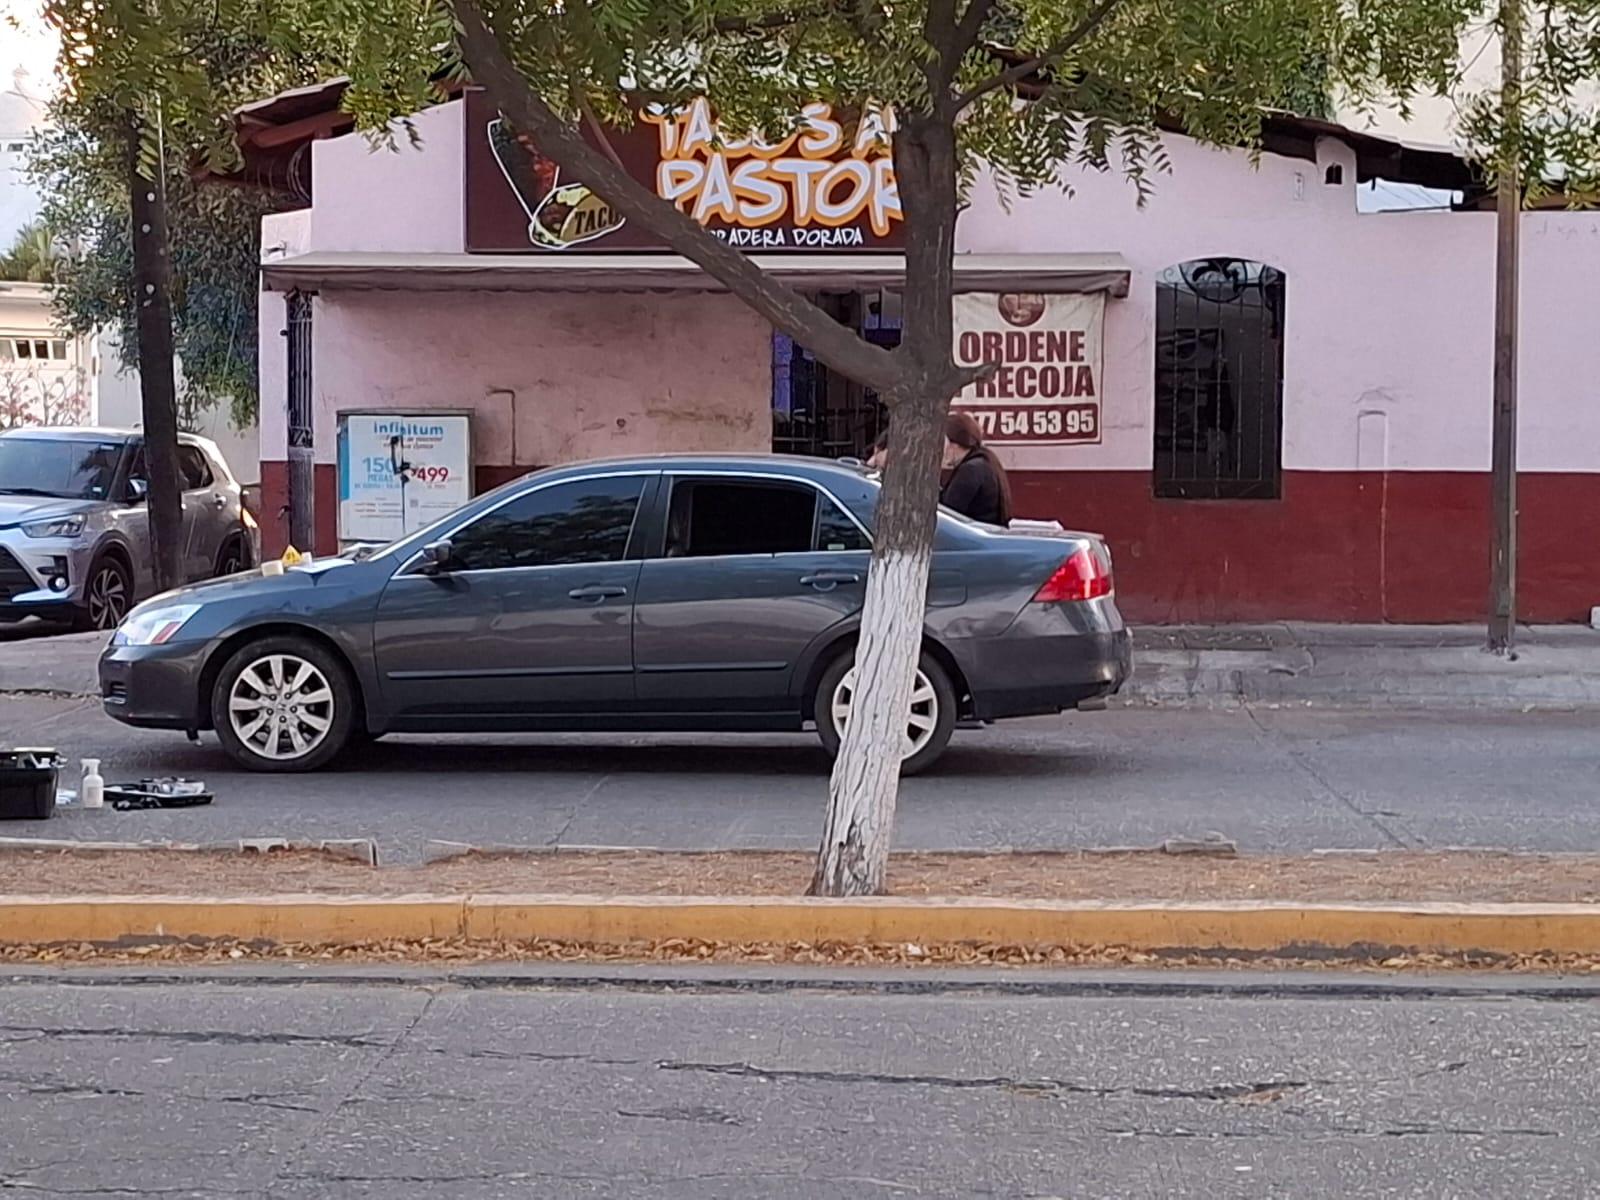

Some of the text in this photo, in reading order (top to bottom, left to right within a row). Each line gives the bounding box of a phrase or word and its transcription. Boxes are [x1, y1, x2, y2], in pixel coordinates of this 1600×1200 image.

[792, 227, 864, 248] DORADA
[959, 331, 1085, 363] ORDENE
[374, 421, 443, 435] infinitum
[1001, 410, 1029, 435] 54
[1033, 410, 1061, 434] 53
[1066, 409, 1093, 433] 95
